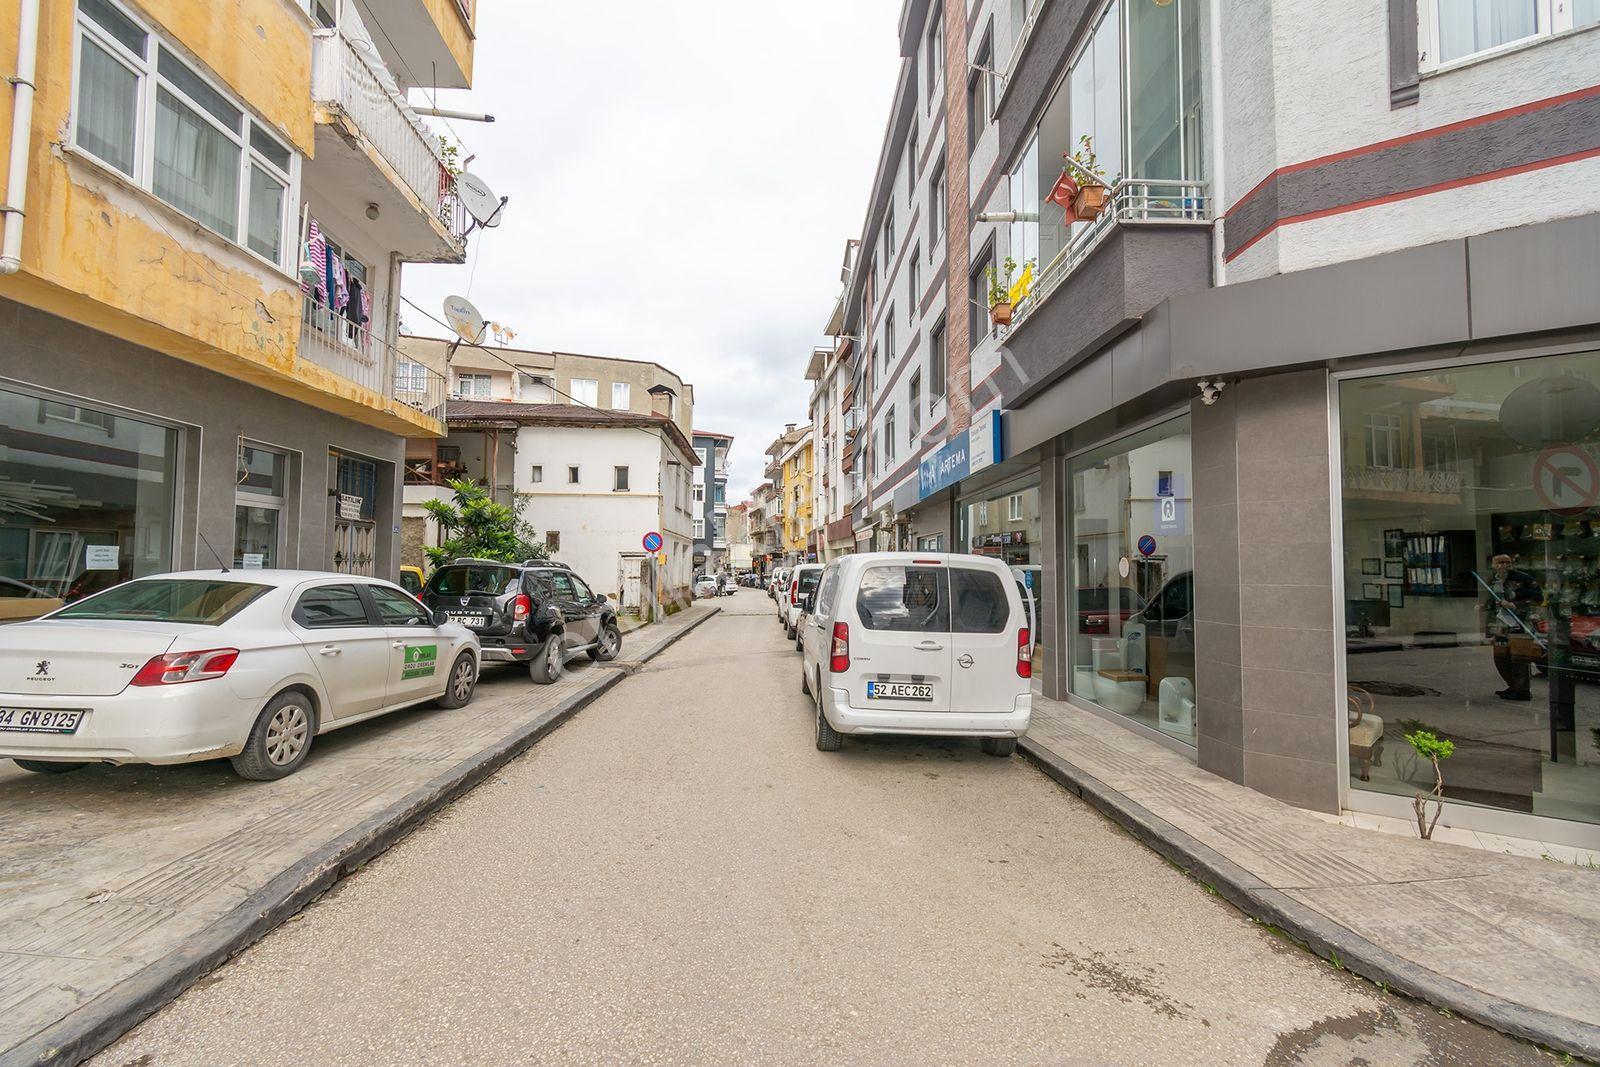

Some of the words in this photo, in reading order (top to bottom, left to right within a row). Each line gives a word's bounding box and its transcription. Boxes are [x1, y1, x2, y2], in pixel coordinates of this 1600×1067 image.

[940, 448, 966, 475] ARTEMA
[470, 617, 484, 625] 731
[873, 684, 887, 695] 52
[890, 685, 911, 696] AEC
[912, 686, 931, 697] 262
[0, 709, 15, 725] 34
[20, 710, 42, 726] GN
[41, 712, 78, 728] 8125
